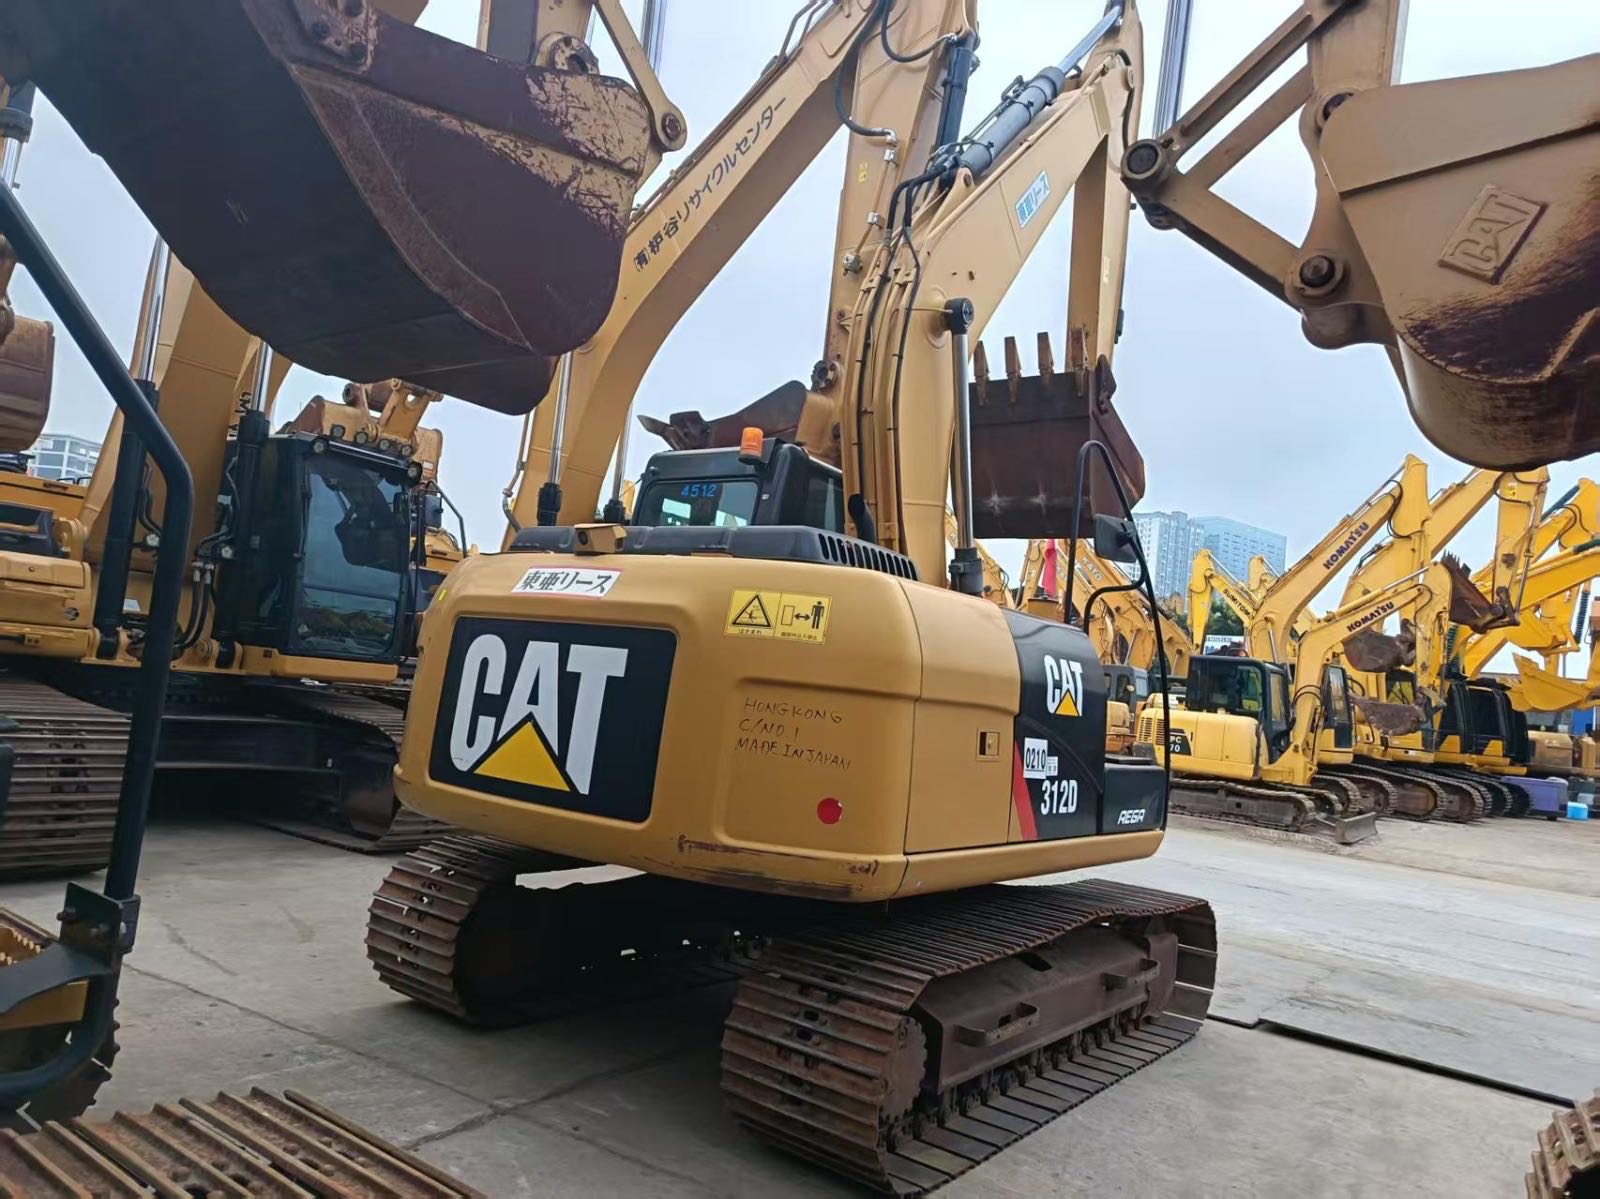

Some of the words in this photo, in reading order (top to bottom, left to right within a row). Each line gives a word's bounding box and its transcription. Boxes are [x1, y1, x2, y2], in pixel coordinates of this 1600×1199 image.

[1446, 193, 1532, 273] CAT
[680, 483, 718, 498] 4512
[1323, 521, 1369, 570] KOMATSU
[518, 570, 612, 593] 東亜リース
[1346, 602, 1395, 632] KOMATSU
[1043, 654, 1083, 717] CAT
[450, 633, 628, 795] CAT
[735, 738, 777, 753] MADE
[1169, 735, 1182, 744] PC
[1169, 743, 1181, 752] 70
[1025, 747, 1047, 770] 0210
[1040, 779, 1078, 815] 312D
